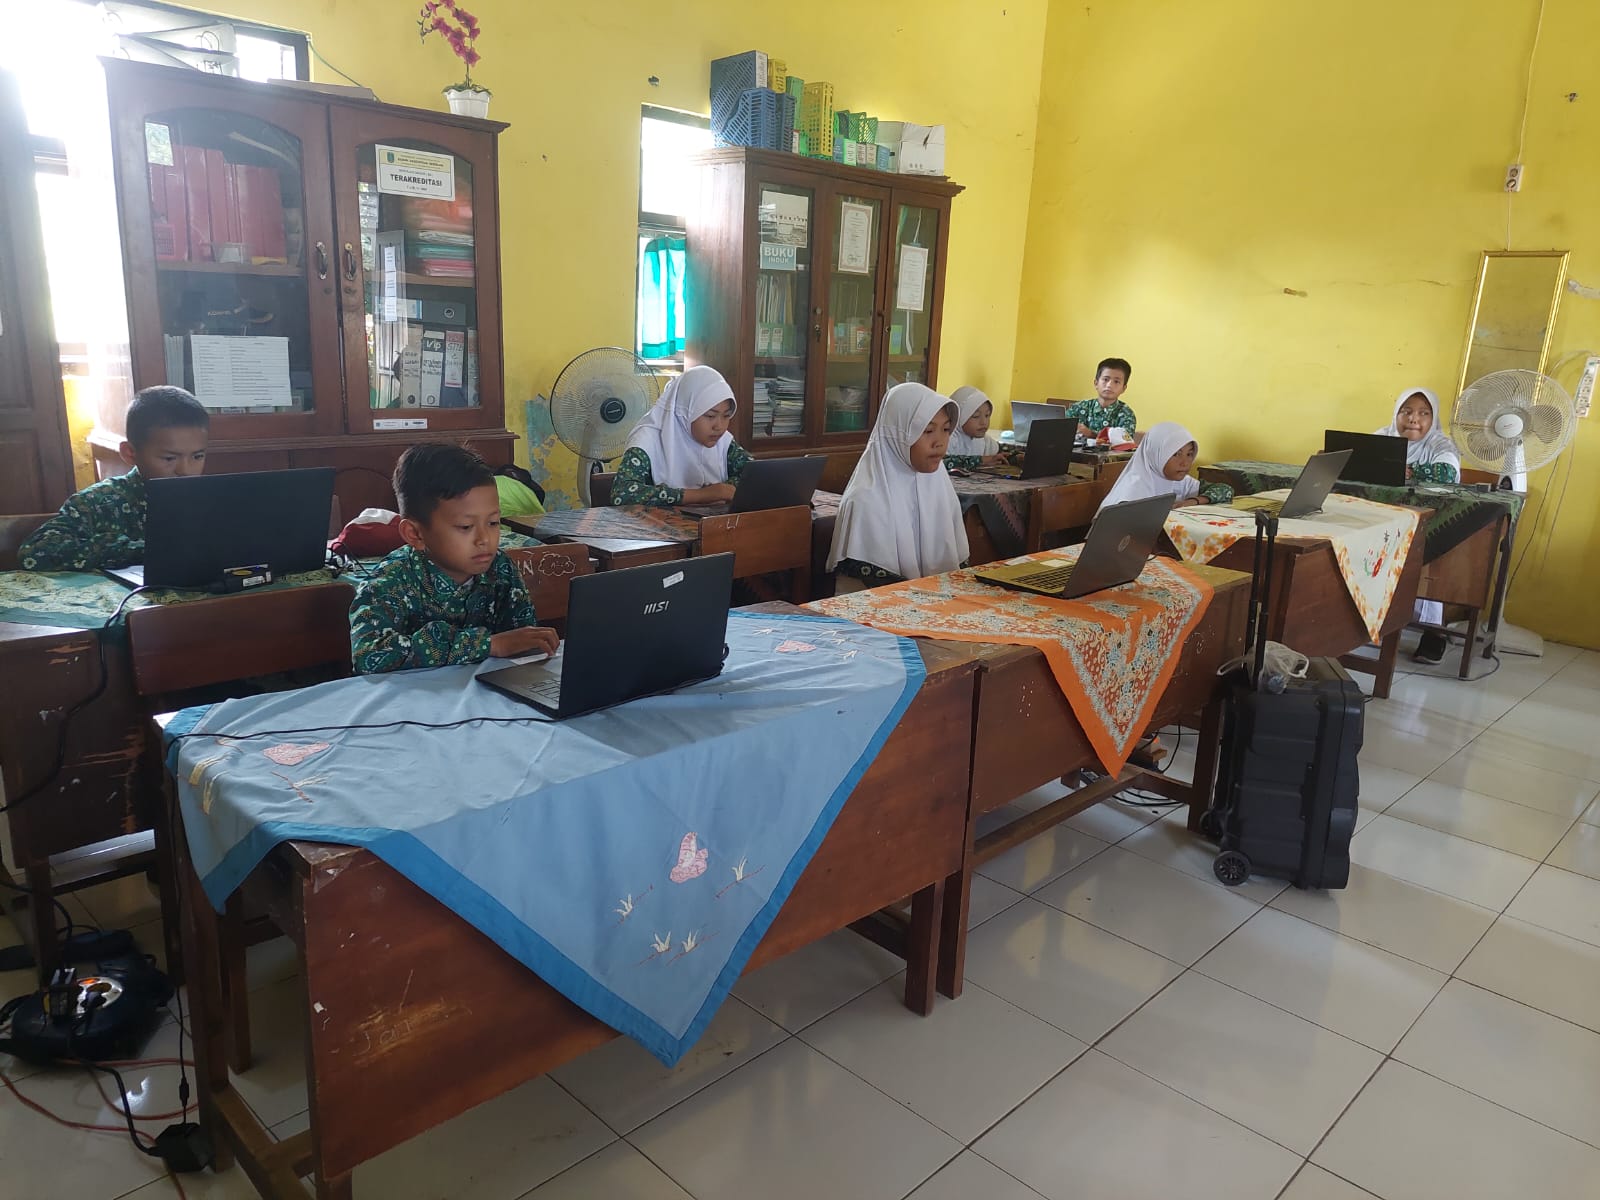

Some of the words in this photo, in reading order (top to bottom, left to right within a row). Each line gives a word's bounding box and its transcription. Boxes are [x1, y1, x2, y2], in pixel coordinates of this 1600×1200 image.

[390, 173, 443, 187] TERAKREDITASI
[764, 246, 794, 258] BUKU
[768, 256, 790, 264] INDUK
[643, 600, 670, 615] MSI
